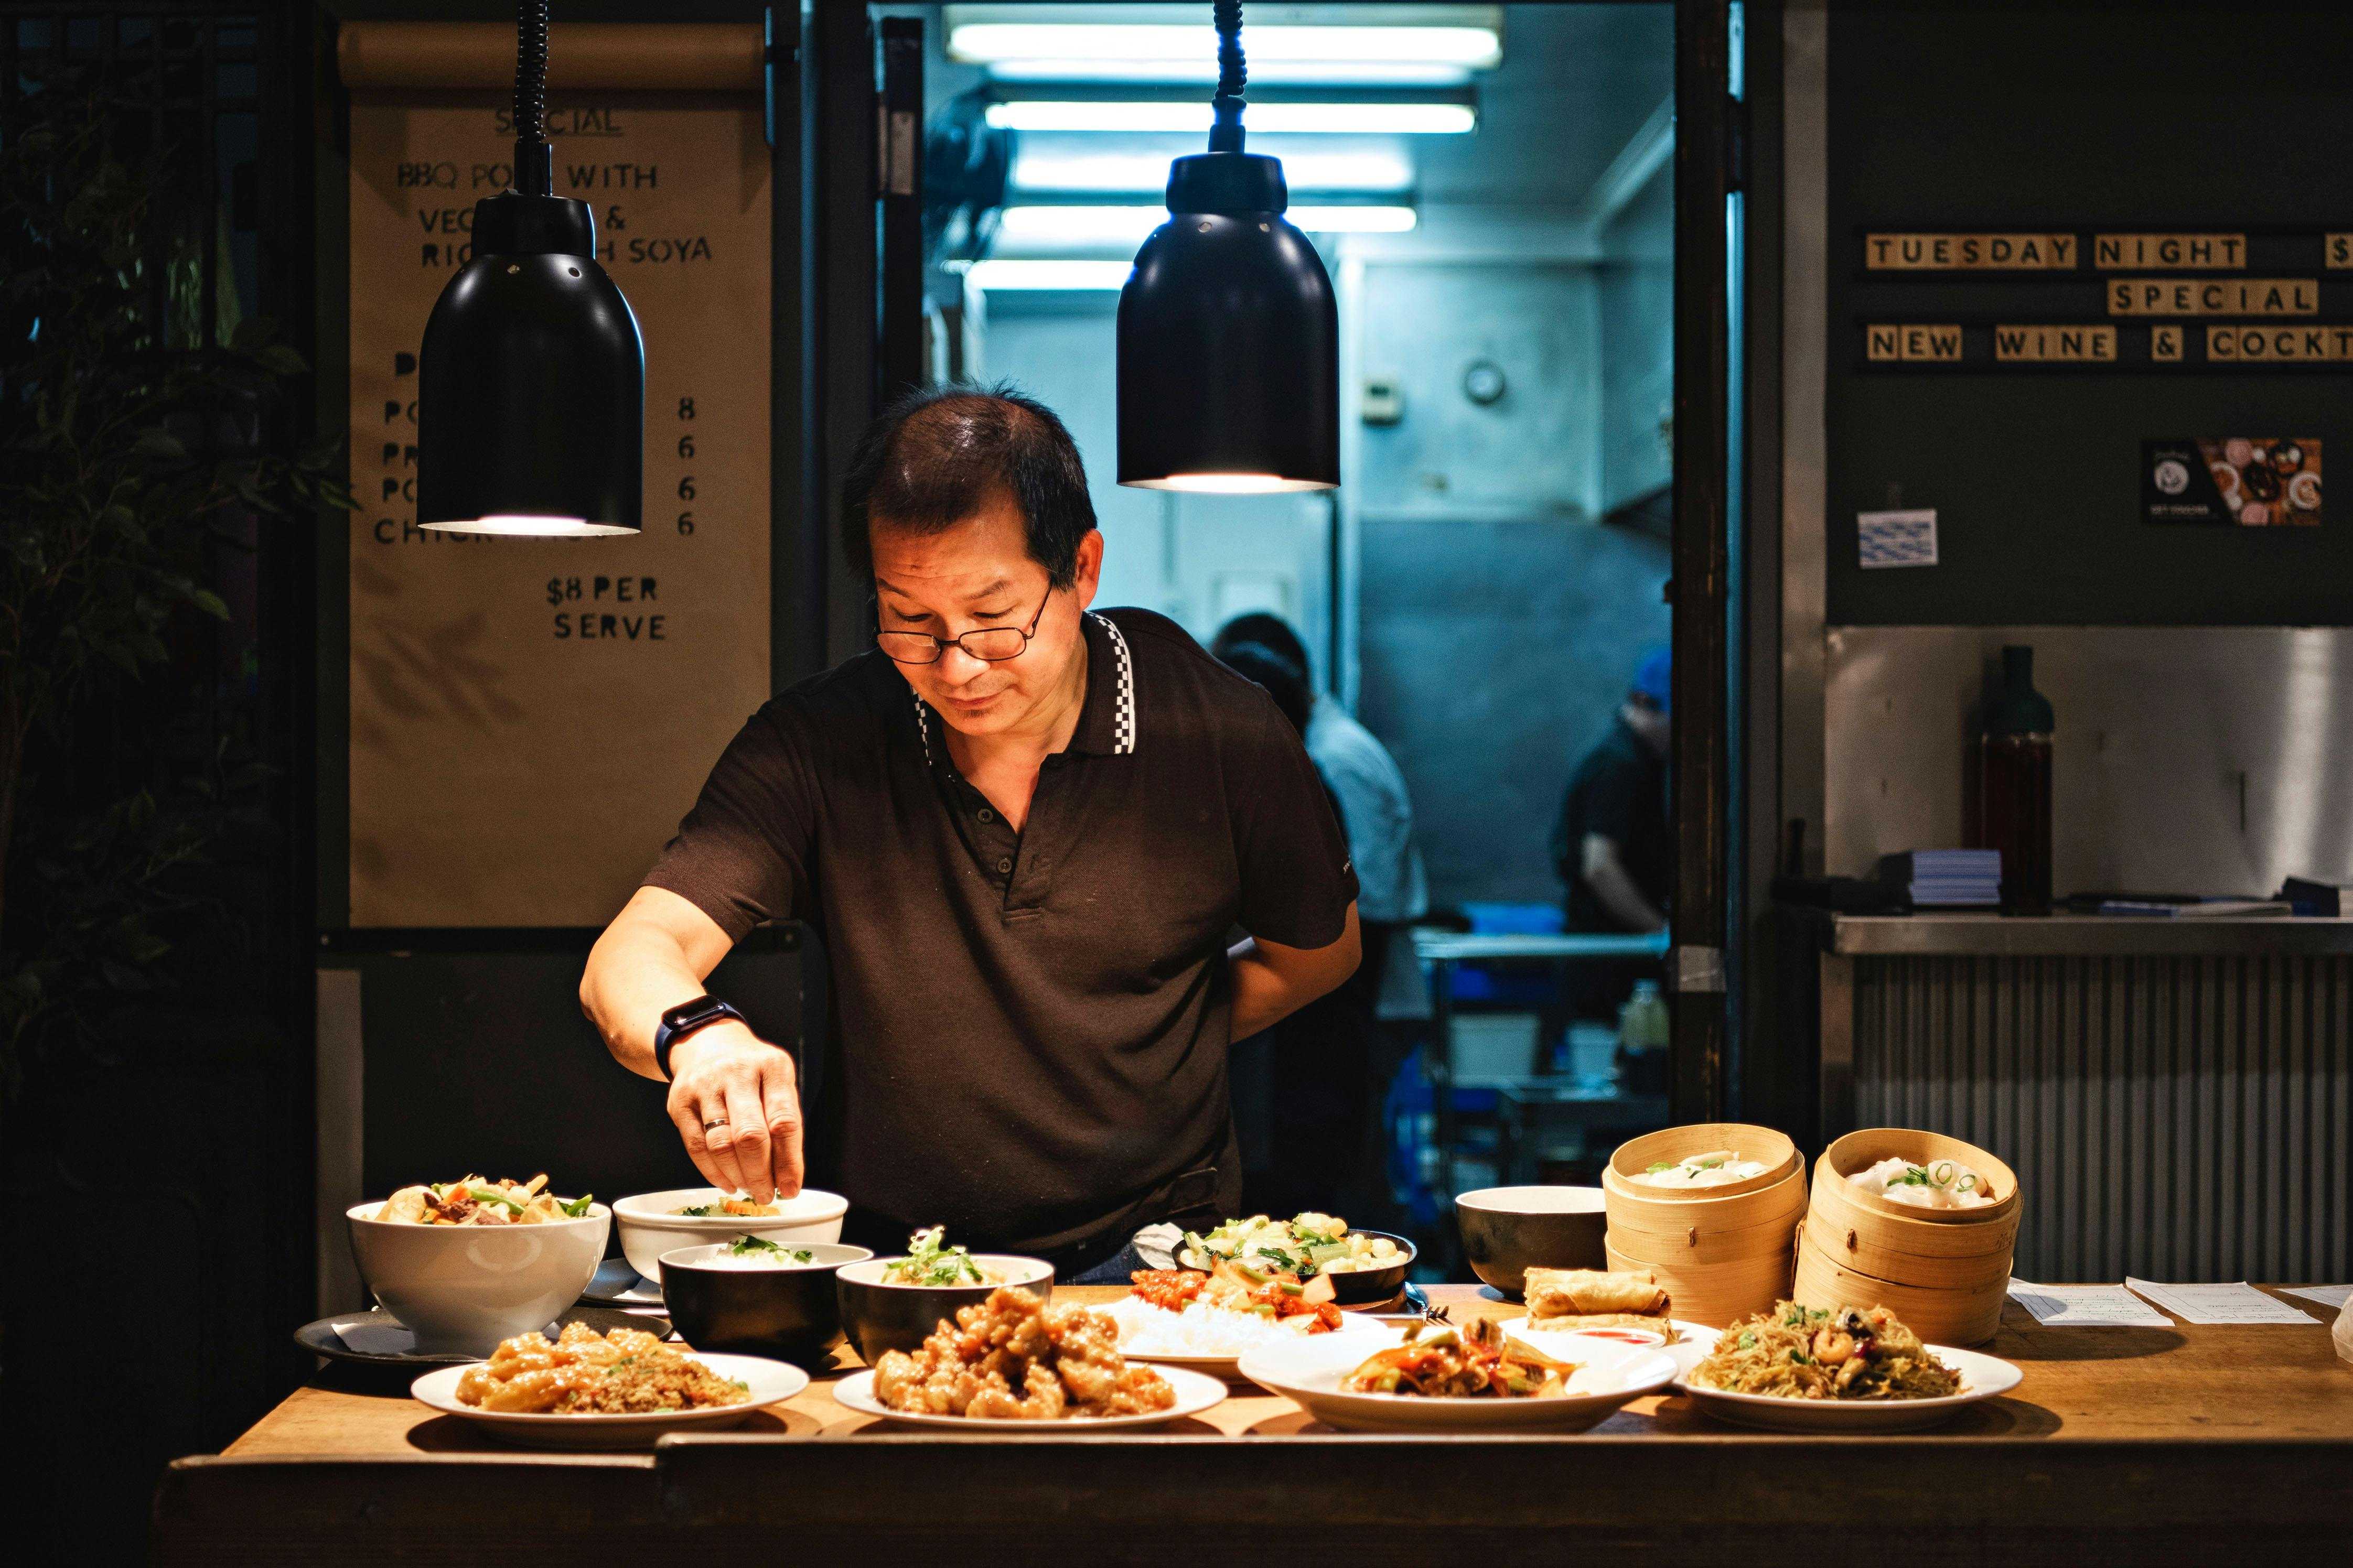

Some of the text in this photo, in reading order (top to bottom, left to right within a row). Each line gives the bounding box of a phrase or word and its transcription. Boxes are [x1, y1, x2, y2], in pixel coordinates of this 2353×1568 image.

[496, 109, 622, 134] SCIAL
[397, 164, 457, 189] BBQ
[567, 164, 657, 188] WITH
[606, 206, 625, 230] &
[630, 236, 712, 263] SOYA
[1874, 239, 2070, 263] TUESDAY
[2100, 239, 2241, 263] NIGHT
[2115, 285, 2311, 310] SPECIAL
[1873, 331, 2353, 358] NEW WINE & COCKT
[678, 396, 695, 420] 8
[678, 435, 695, 459] 6
[678, 475, 695, 501] 6
[677, 511, 694, 536] 6
[547, 576, 657, 605] $8 PER
[554, 613, 667, 640] SERVE
